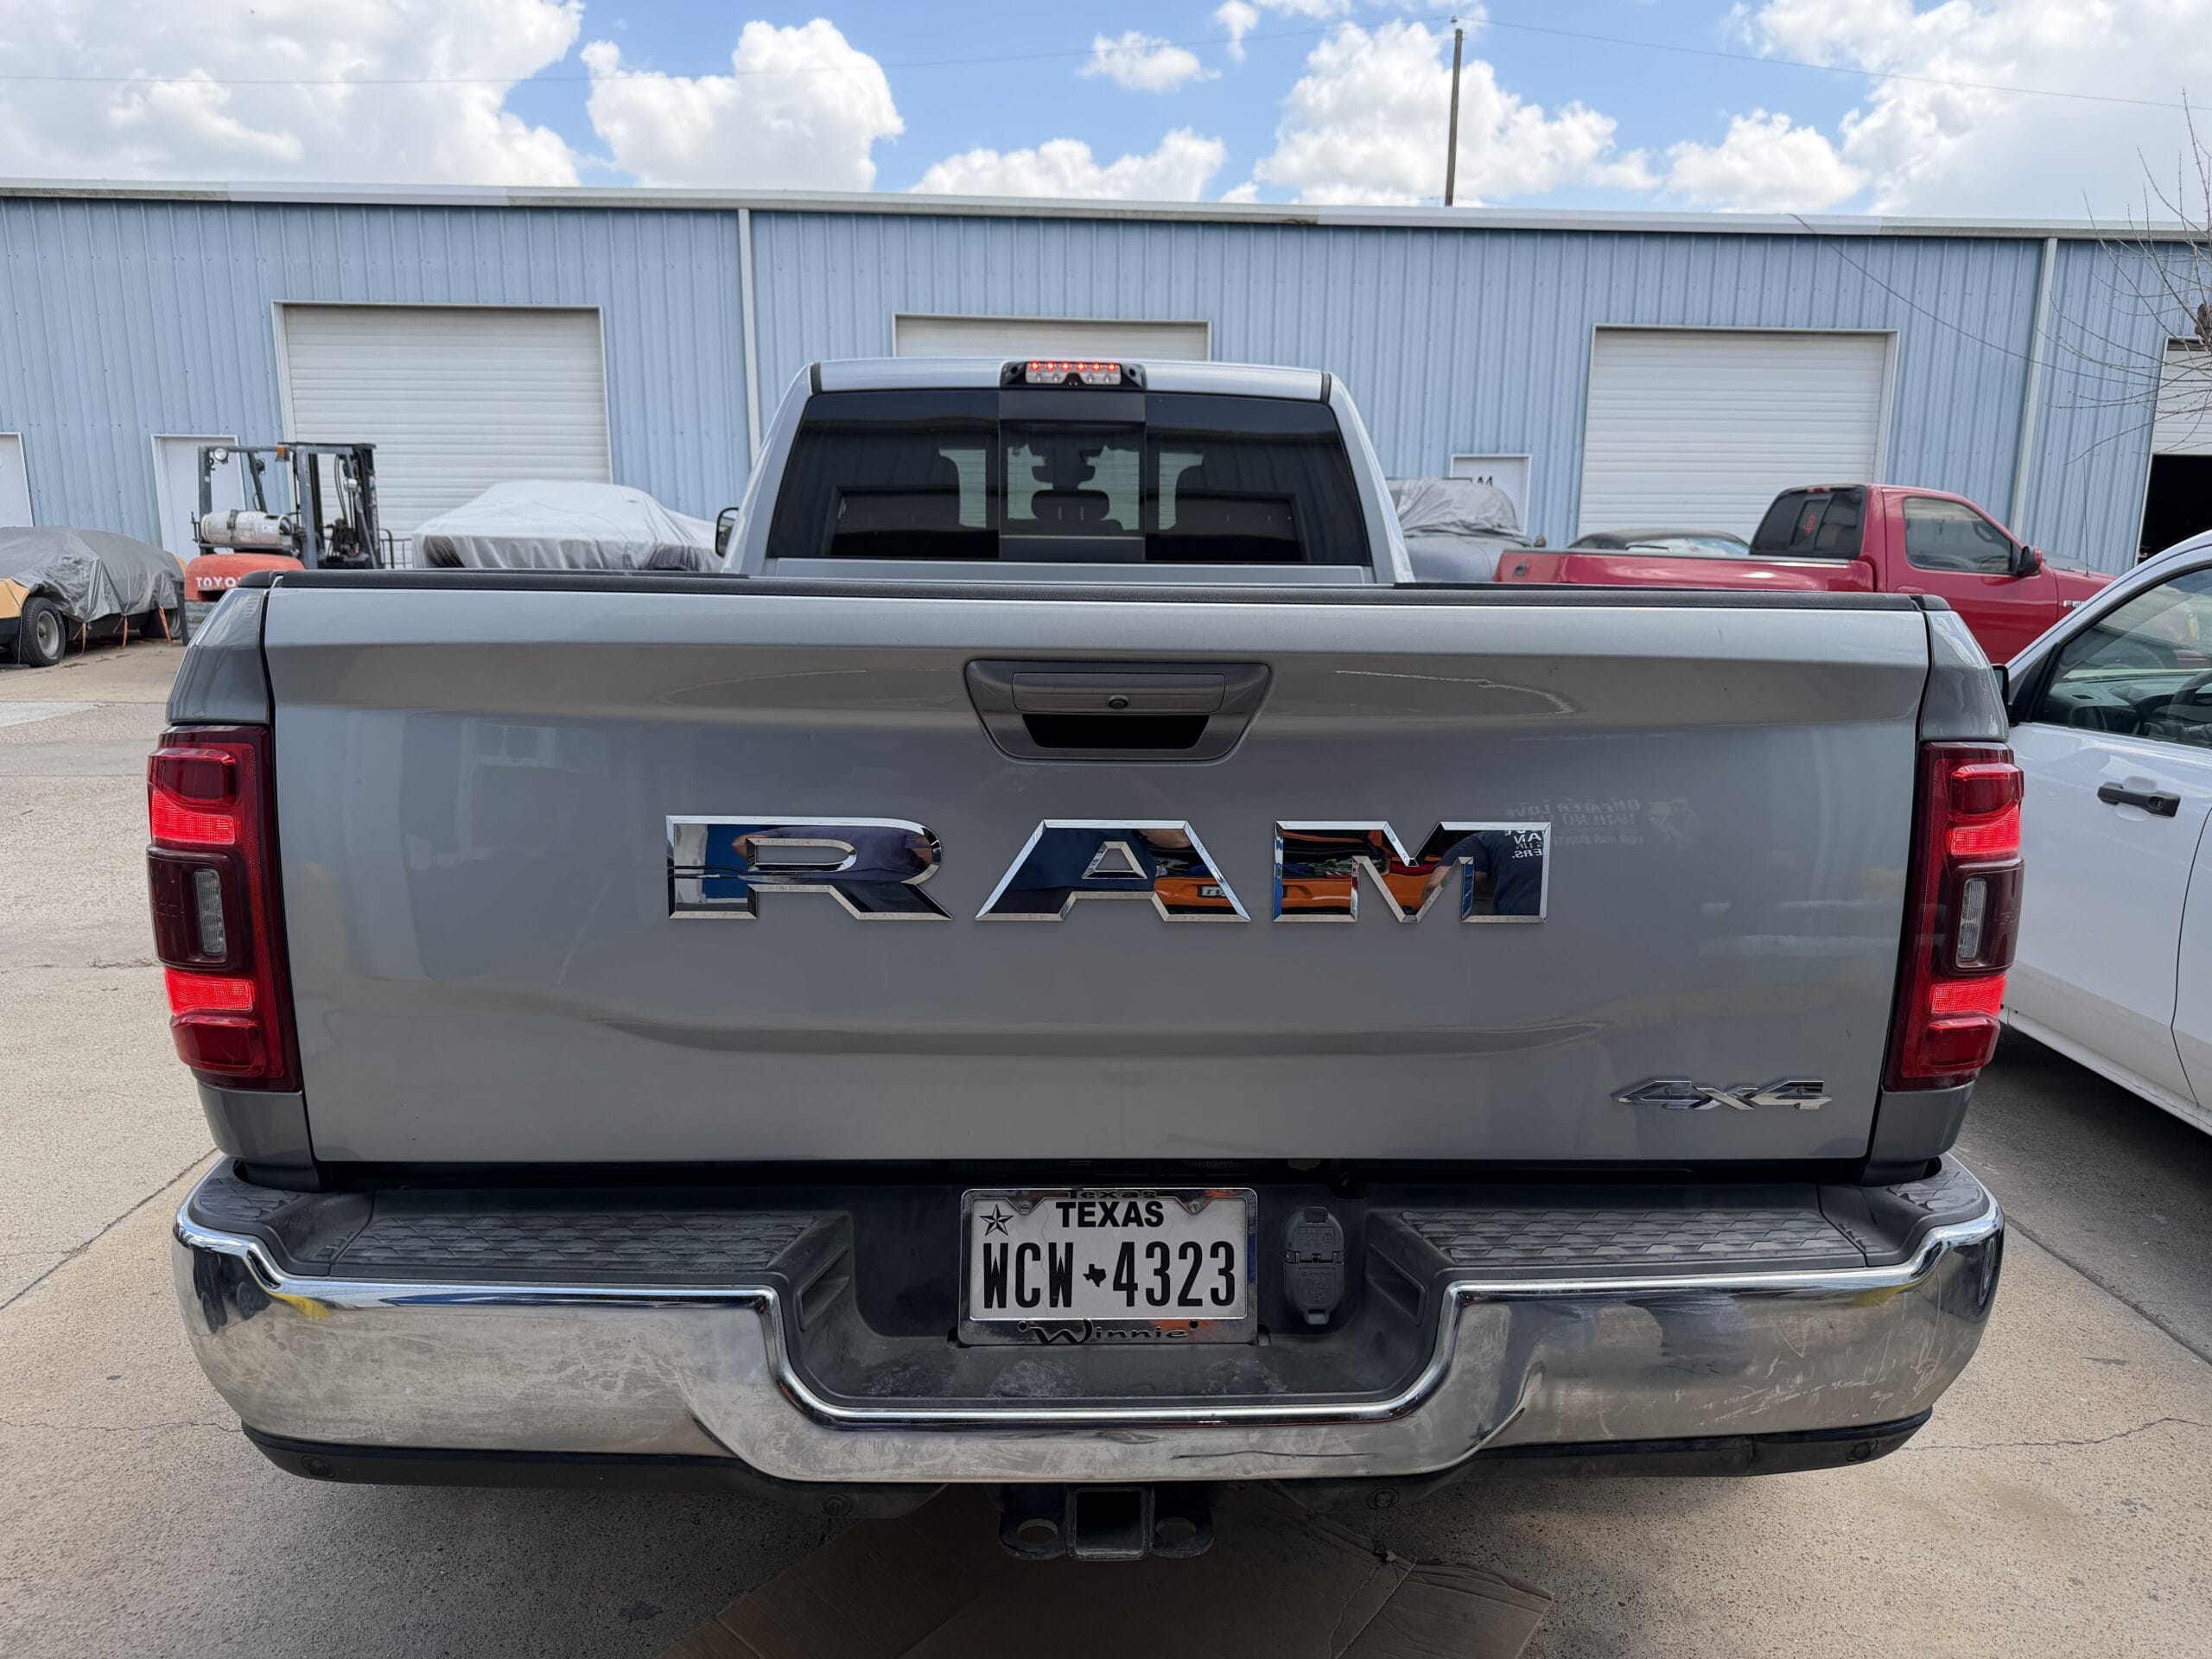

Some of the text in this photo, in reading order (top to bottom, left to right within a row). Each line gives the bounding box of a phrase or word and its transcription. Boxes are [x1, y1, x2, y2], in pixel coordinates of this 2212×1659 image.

[195, 575, 242, 588] TOYO
[666, 816, 1552, 924] RAM
[1055, 1200, 1165, 1228] TEXAS
[983, 1240, 1236, 1309] WCW 4323
[1029, 1319, 1189, 1344] Winnie
